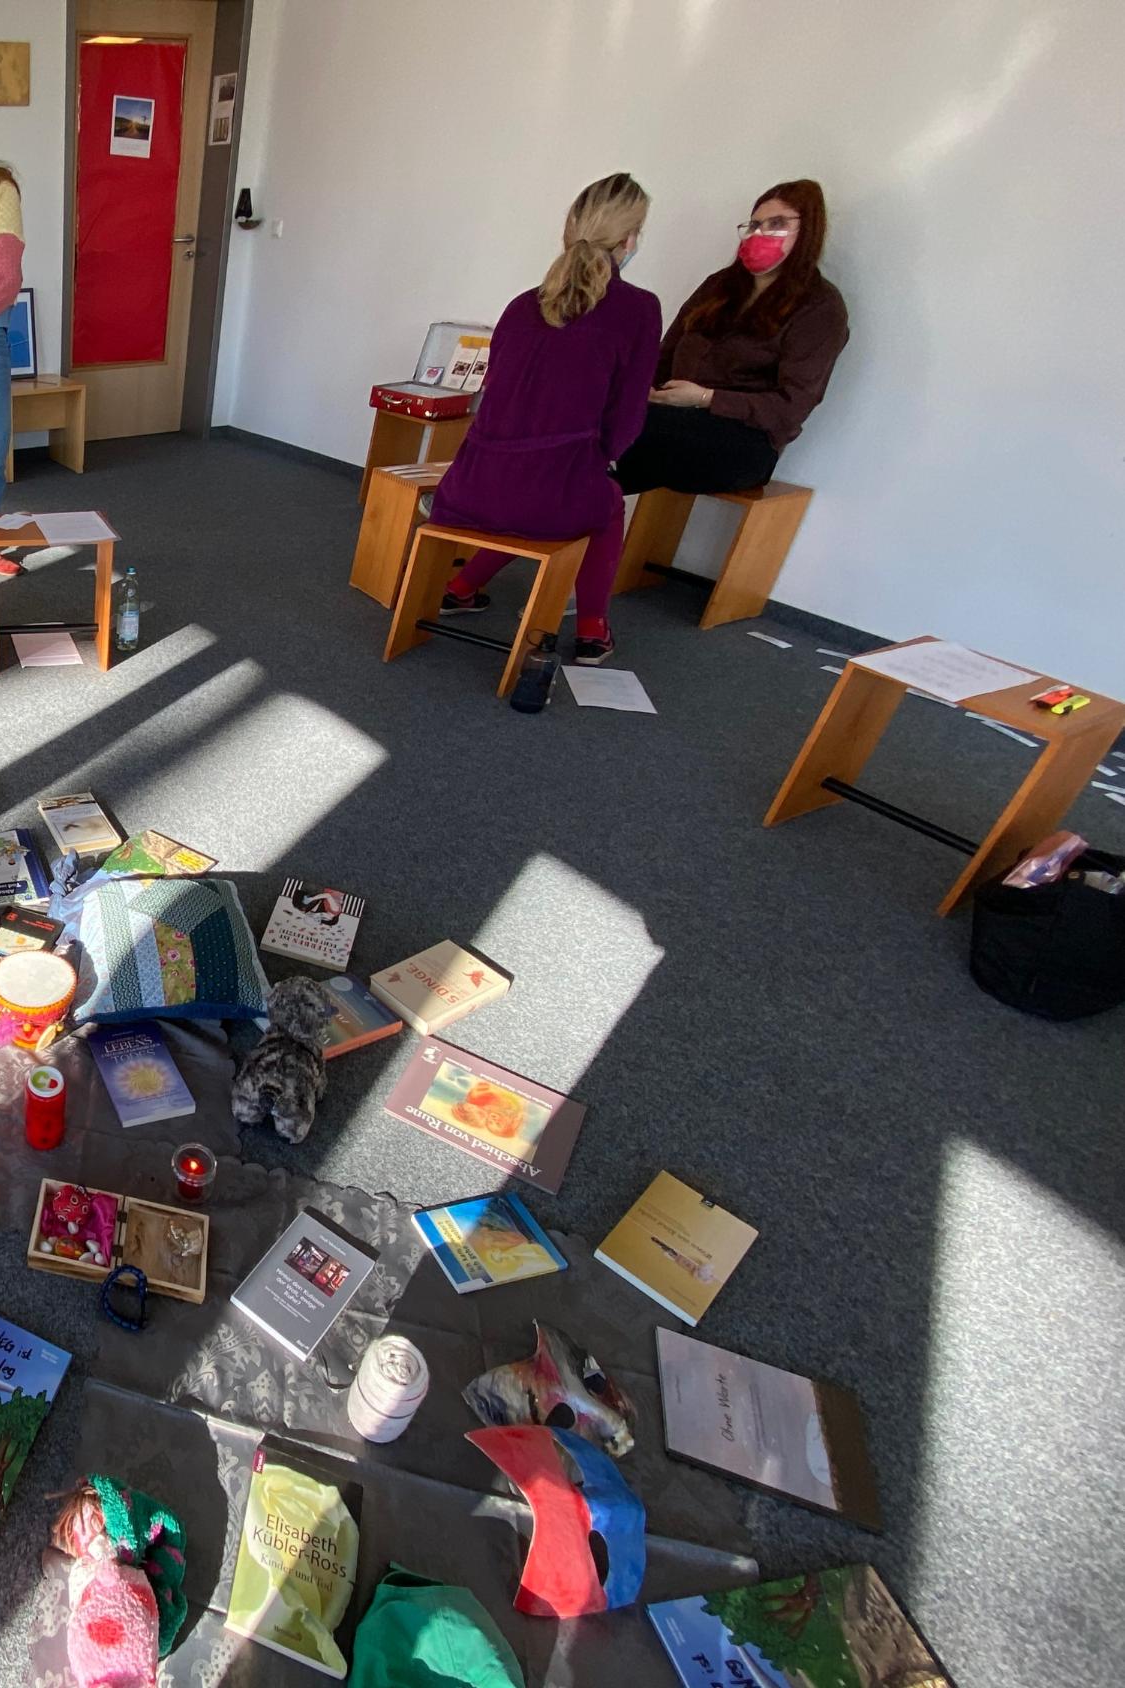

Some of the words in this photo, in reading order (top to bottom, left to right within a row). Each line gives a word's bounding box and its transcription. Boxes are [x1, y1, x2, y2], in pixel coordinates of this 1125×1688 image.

[448, 995, 460, 1004] 5
[104, 1037, 153, 1053] LEBENS
[405, 1105, 443, 1131] Rune
[444, 1125, 470, 1143] von
[471, 1141, 542, 1177] Abschied
[17, 1347, 33, 1360] ist
[721, 1412, 735, 1443] Ohne
[266, 1513, 337, 1556] Elisabeth
[253, 1527, 347, 1578] Kübler-Ross
[260, 1553, 294, 1574] Kinder
[295, 1569, 313, 1584] und
[314, 1577, 334, 1593] Tod
